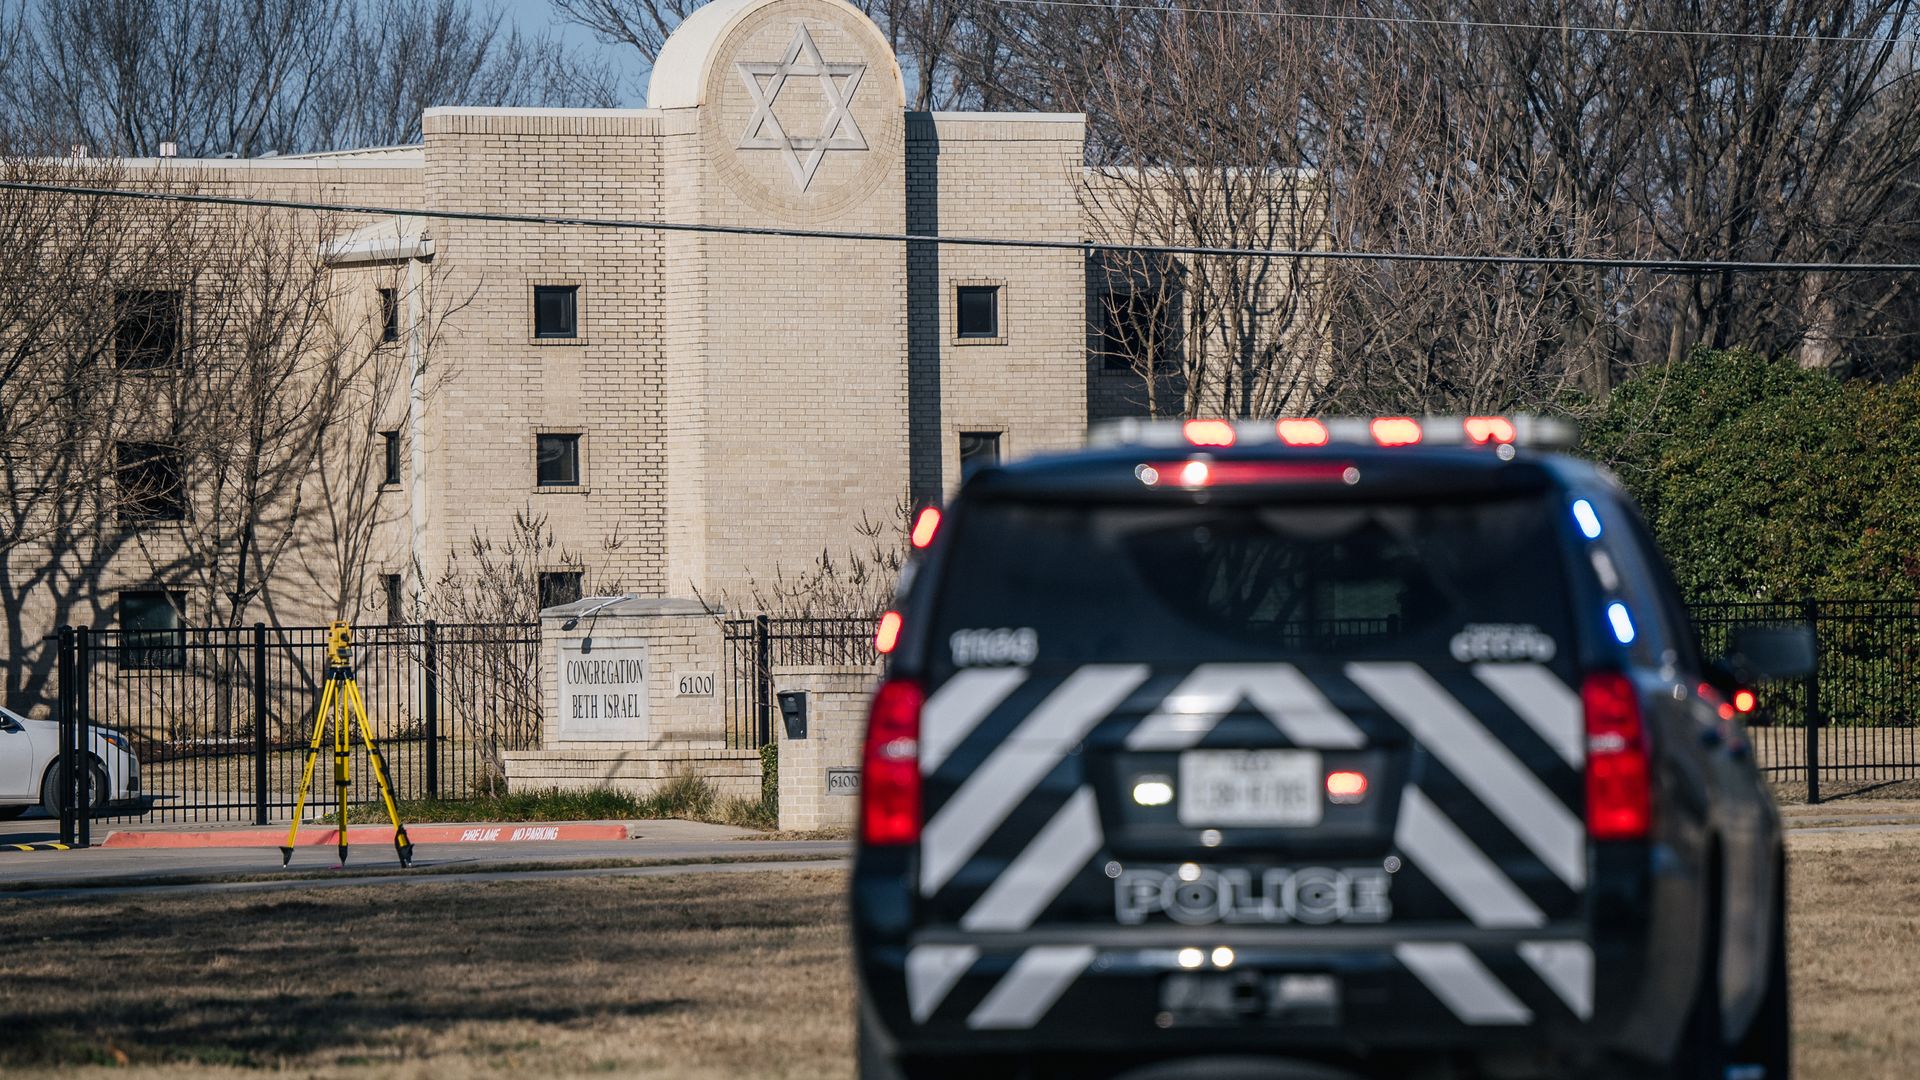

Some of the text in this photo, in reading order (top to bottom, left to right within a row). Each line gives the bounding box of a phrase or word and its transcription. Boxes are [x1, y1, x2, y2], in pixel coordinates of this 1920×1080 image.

[566, 659, 644, 685] CONGREGATION
[679, 676, 712, 694] 6100
[572, 693, 640, 719] BETH ISRAEL
[830, 775, 859, 788] 6100
[461, 827, 559, 841] FIRE LANE NO PARKING
[1114, 868, 1393, 925] POLICE
